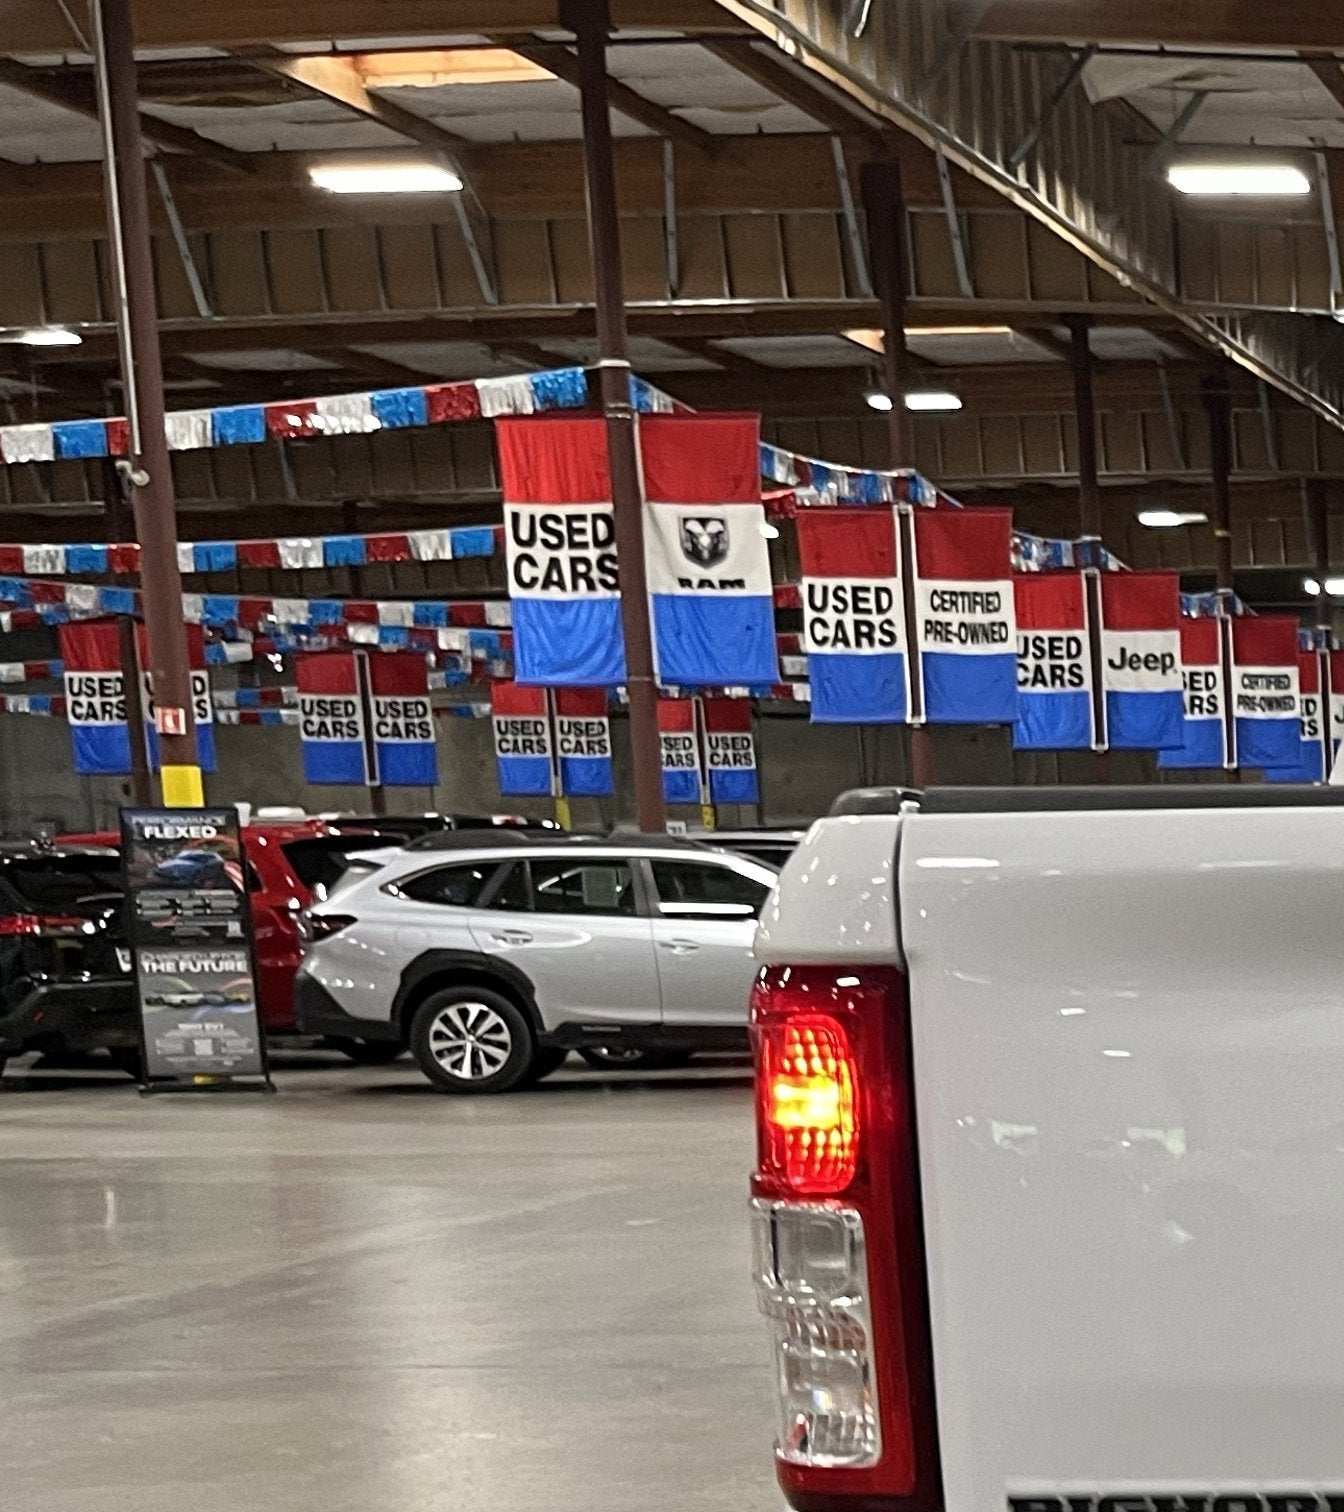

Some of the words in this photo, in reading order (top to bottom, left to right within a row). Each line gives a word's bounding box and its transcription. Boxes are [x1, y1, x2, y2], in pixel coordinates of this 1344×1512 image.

[511, 511, 616, 550] USED
[513, 553, 619, 592] CARS
[677, 576, 746, 590] RAM
[807, 583, 893, 615] USED
[930, 589, 1001, 614] CERTIFIED
[809, 616, 897, 648] CARS
[924, 619, 1009, 645] PRE-OWNED
[1107, 647, 1175, 675] Jeep
[1017, 662, 1084, 688] CARS
[1182, 671, 1217, 691] ED
[1241, 673, 1291, 690] CERTIFIED
[69, 677, 125, 697] USED
[71, 700, 127, 721] CARS
[301, 698, 356, 717] USED
[376, 700, 428, 718] USED
[1184, 694, 1218, 715] RS
[1236, 693, 1296, 712] PRE-OWNED
[303, 720, 359, 738] CARS
[376, 721, 431, 739] CARS
[496, 719, 545, 737] USED
[560, 720, 606, 737] USED
[498, 738, 547, 755] CARS
[560, 738, 608, 755] CARS
[662, 736, 693, 751] SED
[708, 736, 750, 751] USED
[664, 753, 695, 767] ARS
[709, 752, 753, 768] CARS
[144, 825, 217, 839] FLEXED
[141, 960, 176, 973] THE
[179, 960, 247, 973] FUTURE
